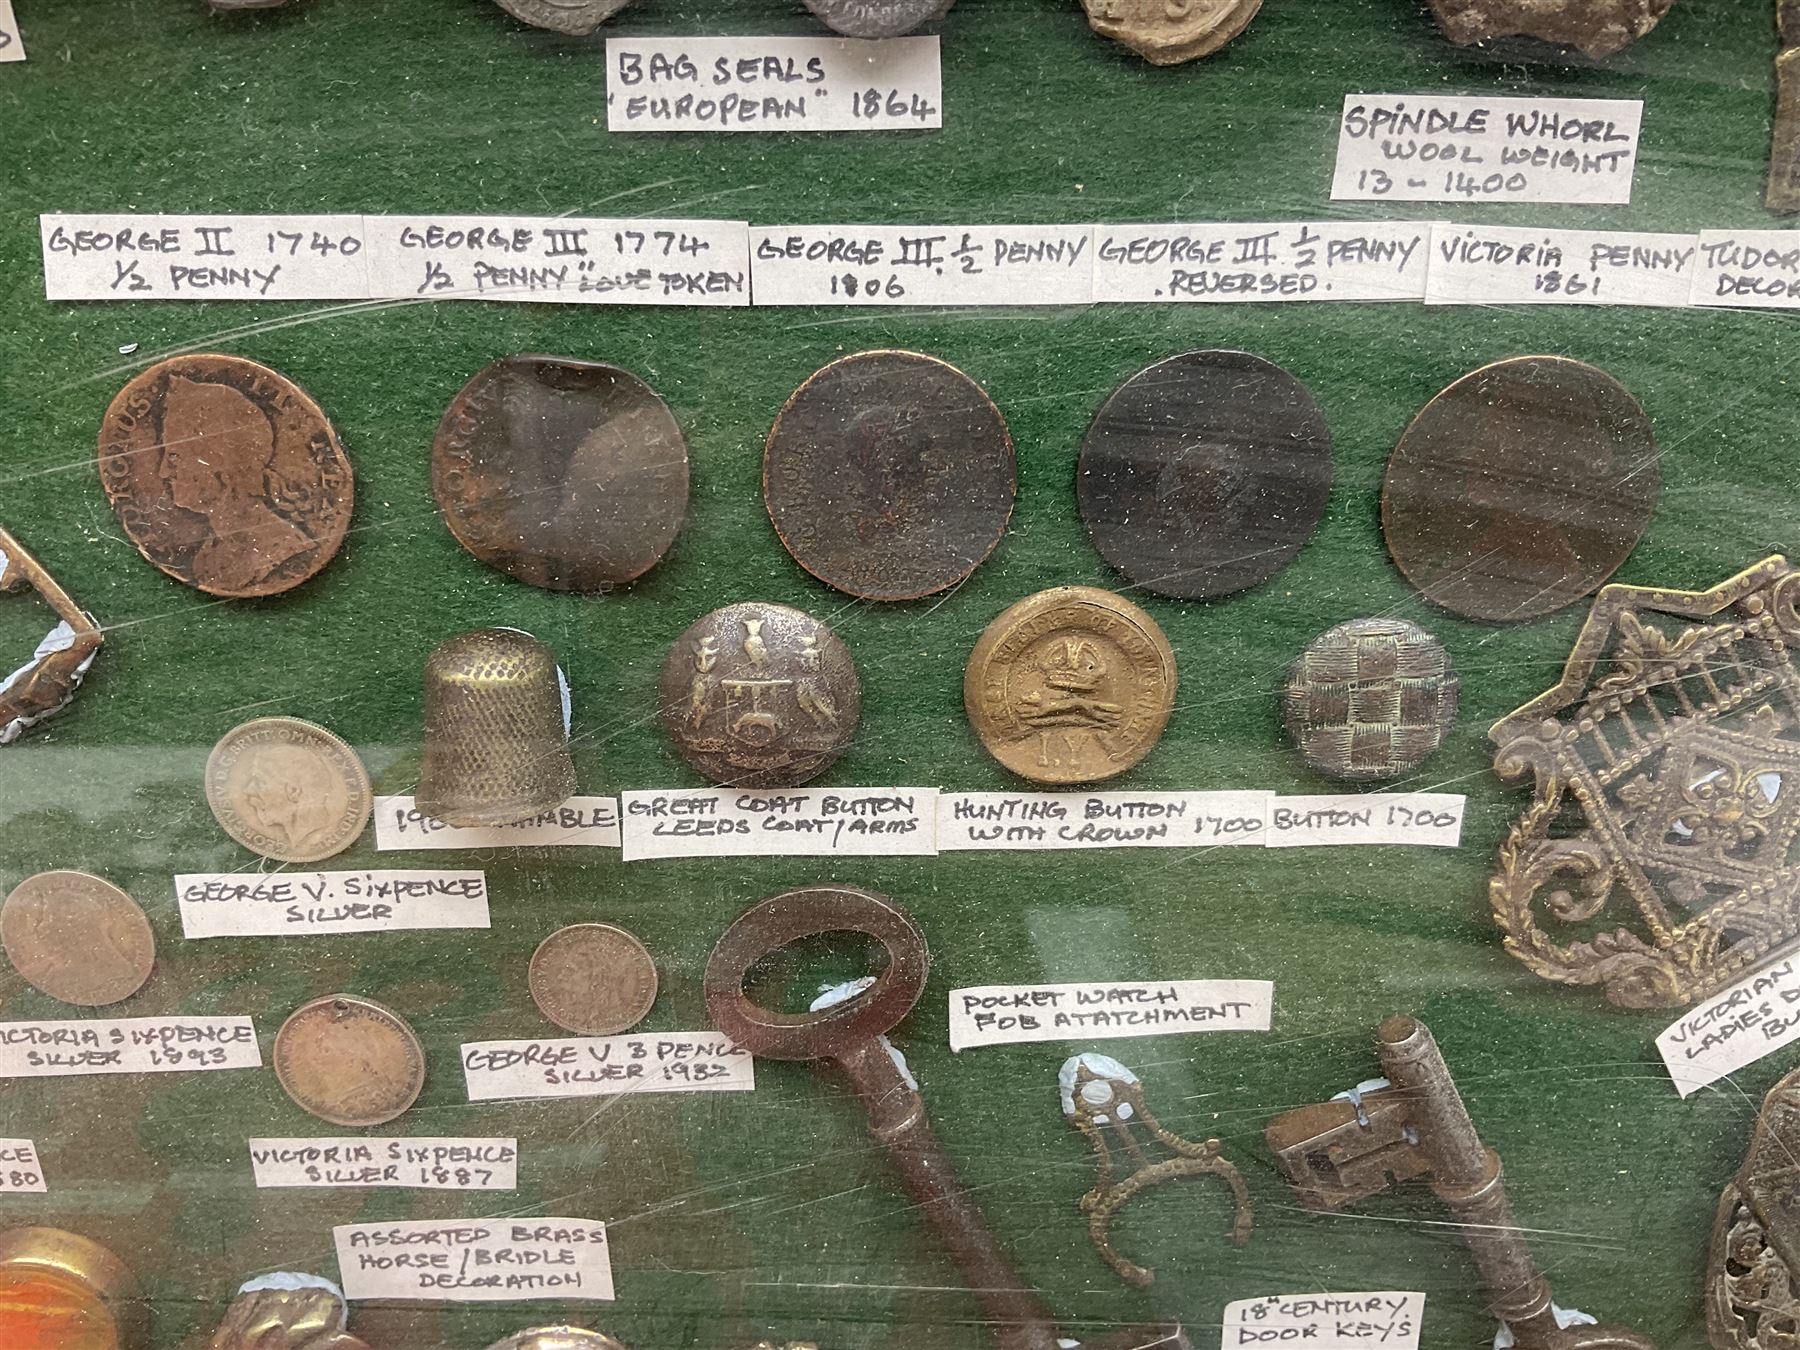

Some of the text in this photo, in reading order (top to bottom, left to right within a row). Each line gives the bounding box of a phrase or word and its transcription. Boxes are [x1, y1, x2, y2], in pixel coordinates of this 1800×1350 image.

[619, 52, 826, 86] BAG SEALS
[852, 87, 937, 122] 1864
[1505, 110, 1630, 143] WHORL
[1381, 140, 1630, 174] WOOL WEIGHT
[1357, 169, 1393, 195] 13
[1444, 171, 1528, 197] 1400
[49, 226, 362, 257] GEORGE II 1740
[399, 225, 710, 257] GEORGE III 1774
[756, 236, 884, 266] GEORGE
[993, 236, 1088, 268] PENNY
[1098, 237, 1226, 267] GEORGE
[1326, 236, 1422, 273] PENNY
[1590, 243, 1694, 273] PENNY
[1701, 240, 1800, 273] TUDOR
[169, 264, 281, 296] PENNY
[473, 260, 569, 293] PENNY
[660, 270, 744, 296] TOKEN
[1535, 270, 1602, 296] 1861
[628, 795, 914, 817] GREAT COAT BUTTON
[954, 799, 1187, 820] HUNTING BUTTON
[1274, 806, 1457, 830] BUTTON 1700
[653, 819, 751, 836] LEEDS
[968, 827, 1046, 841] WITH
[1058, 824, 1168, 842] CROWN
[184, 881, 297, 902] GEORGE
[287, 904, 393, 923] SILVER
[963, 986, 1178, 1014] POCKET WATCH
[1670, 961, 1793, 1043] VICTORIAN
[976, 1002, 1251, 1031] FOB ATATCHMENT
[0, 1025, 252, 1049] ICTORIA SIXPENCE
[28, 1048, 228, 1066] SILVER 1893
[465, 1044, 578, 1071] GEORGE
[590, 1044, 611, 1062] V
[627, 1041, 648, 1060] 3
[544, 1062, 731, 1085] SILVER 1932
[0, 1148, 33, 1162] CE
[253, 1142, 516, 1165] VICTORIA SIXPENCE
[305, 1165, 493, 1185] SILVER 1887
[350, 1226, 604, 1247] ASSORTED BRASS
[419, 1272, 582, 1289] DECORATION
[1239, 1321, 1412, 1344] DOOR KEYS
